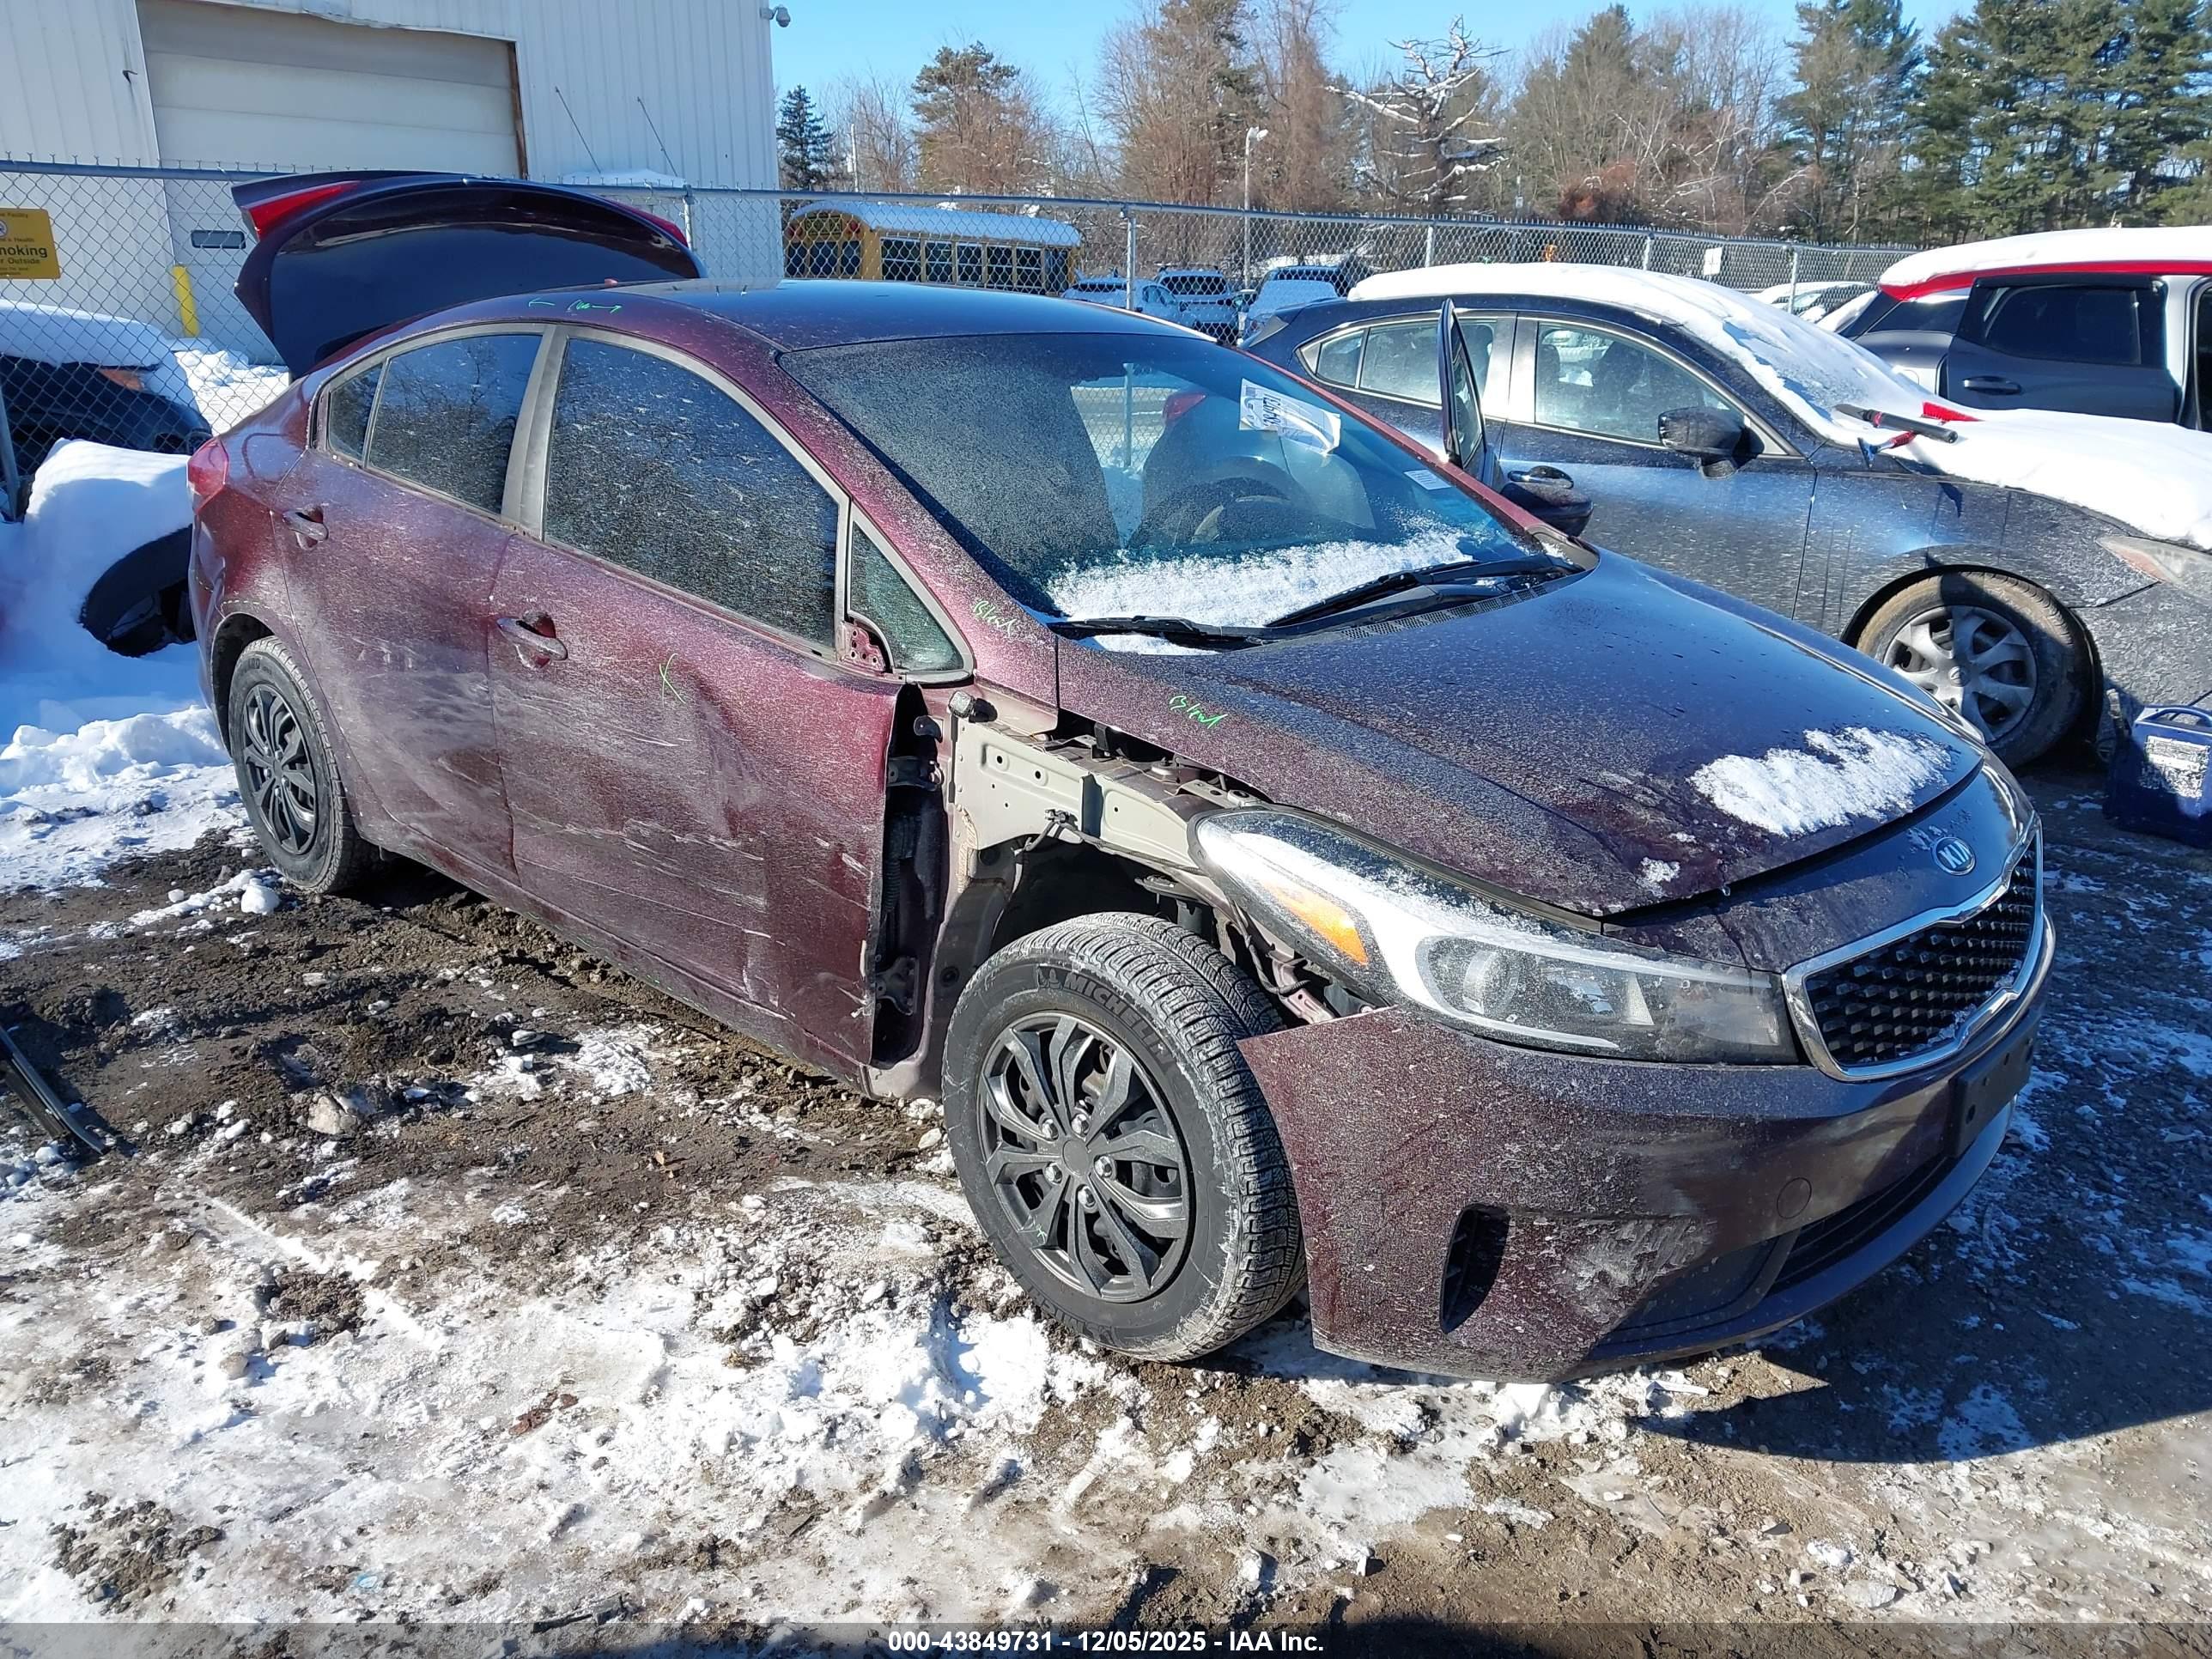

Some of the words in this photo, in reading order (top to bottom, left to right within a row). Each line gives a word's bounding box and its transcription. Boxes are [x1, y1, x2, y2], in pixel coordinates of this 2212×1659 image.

[0, 245, 48, 258] moking
[1938, 841, 1973, 869] KIA
[1064, 971, 1175, 1066] MICHELIN
